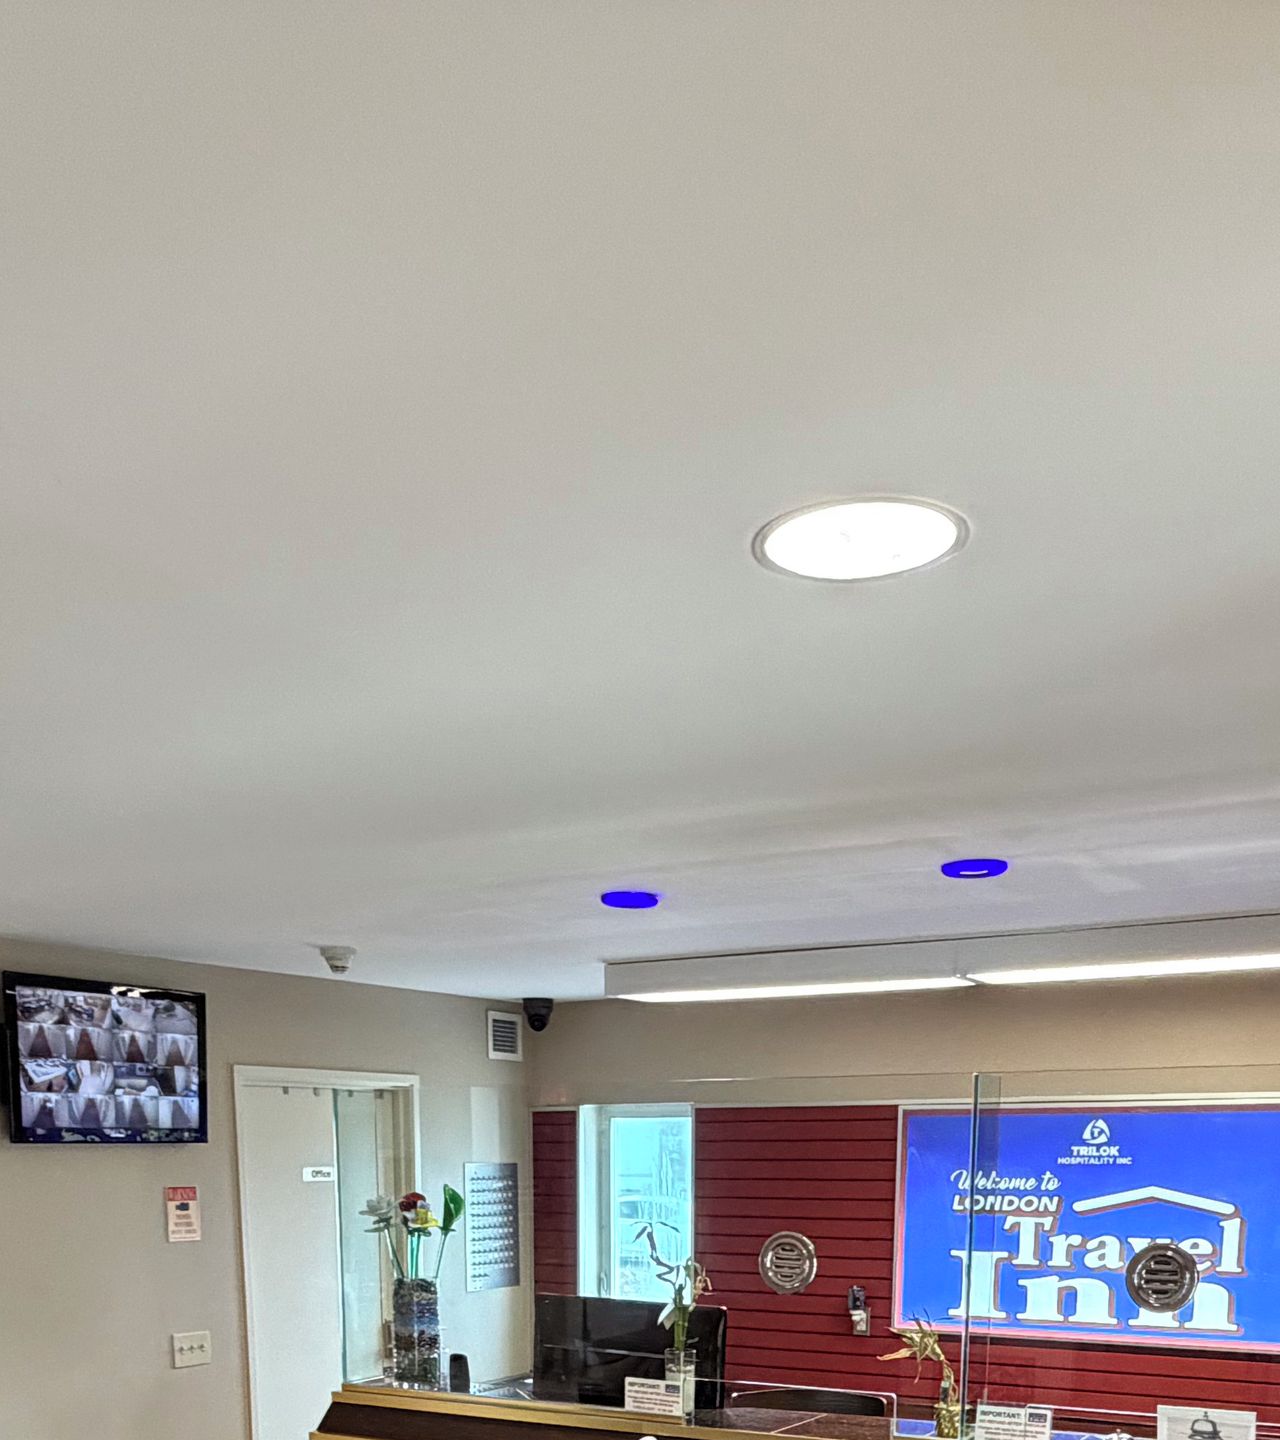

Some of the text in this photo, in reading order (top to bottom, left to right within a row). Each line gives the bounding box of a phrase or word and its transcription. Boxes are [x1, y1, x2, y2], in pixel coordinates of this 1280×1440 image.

[1070, 1146, 1120, 1156] TRILOK
[1057, 1157, 1132, 1165] HOSPITALITY INC
[950, 1169, 1061, 1192] Welcome to
[952, 1194, 1059, 1213] LONDON
